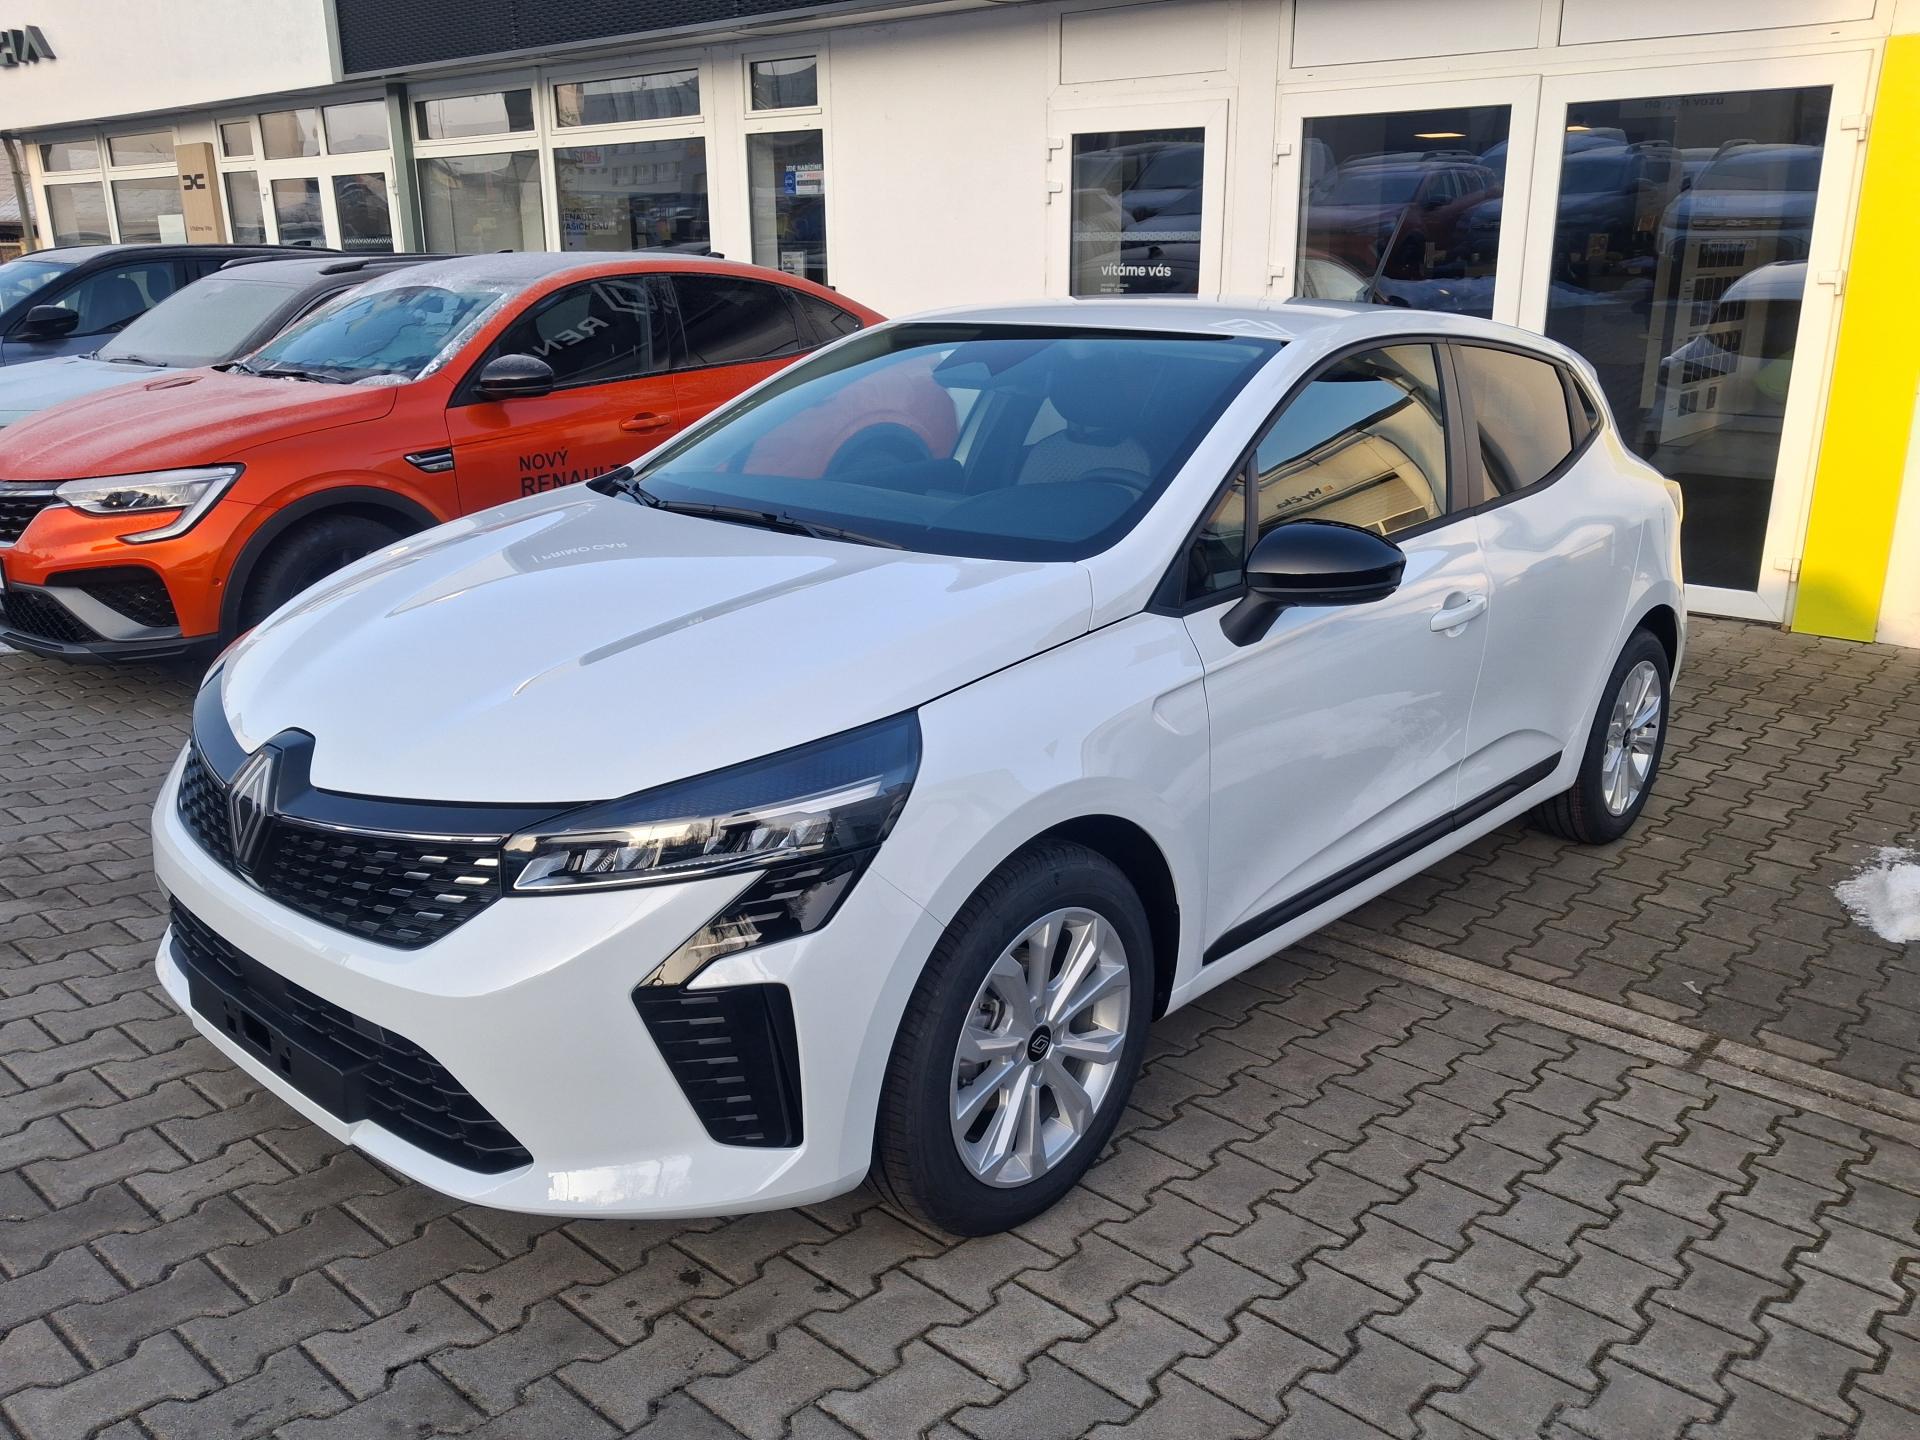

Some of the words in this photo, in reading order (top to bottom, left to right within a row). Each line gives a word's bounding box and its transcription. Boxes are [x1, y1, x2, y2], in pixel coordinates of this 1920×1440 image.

[1101, 263, 1146, 277] vítáme
[1148, 263, 1172, 277] vás
[519, 446, 568, 472] NOVÝ
